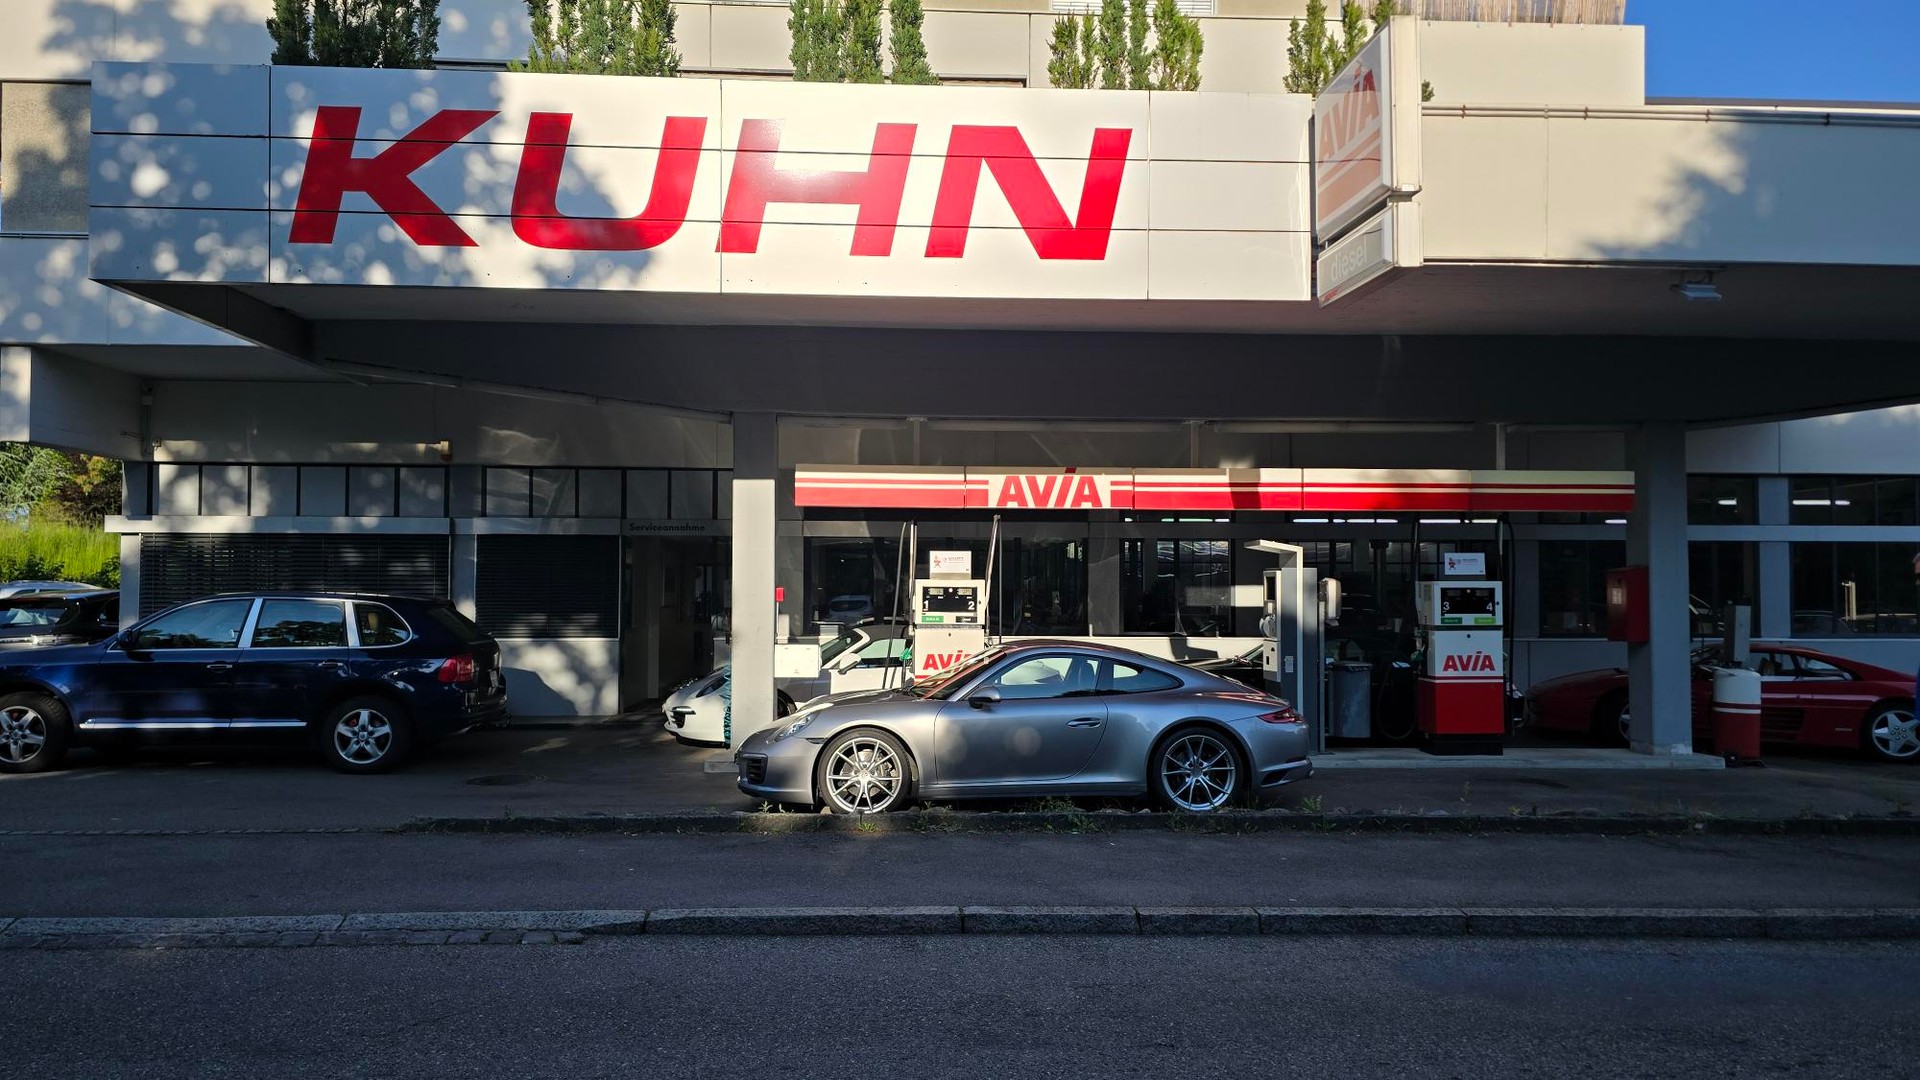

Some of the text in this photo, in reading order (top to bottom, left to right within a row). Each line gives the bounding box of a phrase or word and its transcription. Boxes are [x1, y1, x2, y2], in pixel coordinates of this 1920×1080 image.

[1319, 65, 1380, 168] AVIA
[288, 105, 1133, 260] KUHN
[1331, 234, 1368, 281] diesel
[996, 467, 1103, 508] AVIA
[629, 522, 705, 532] Serviceannahme
[923, 600, 929, 610] 1
[968, 601, 975, 610] 2
[1443, 601, 1450, 611] 3
[1486, 602, 1493, 611] 4
[1443, 651, 1496, 672] AVIA
